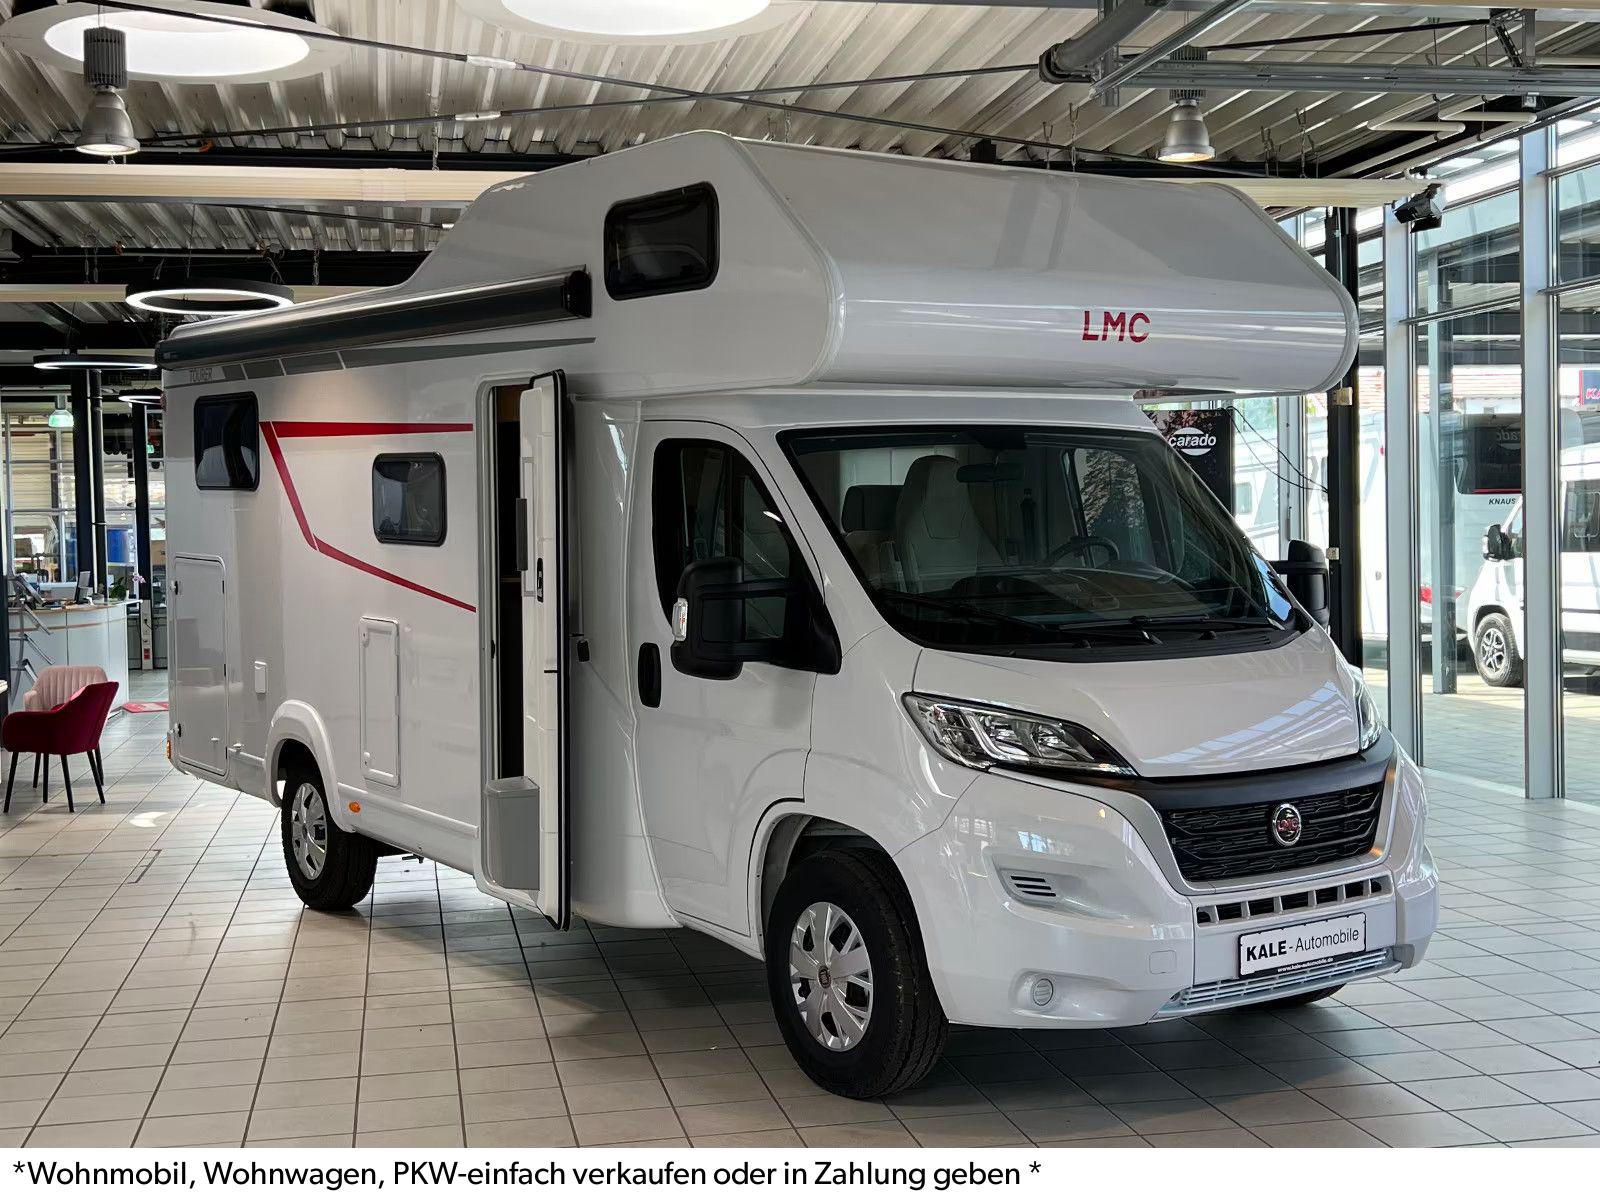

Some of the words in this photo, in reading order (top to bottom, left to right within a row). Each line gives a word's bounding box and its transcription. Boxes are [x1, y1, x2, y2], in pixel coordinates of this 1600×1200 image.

[1082, 311, 1151, 343] LMC
[1168, 433, 1217, 447] carado
[1488, 497, 1516, 505] KNAUS
[1246, 940, 1287, 961] KALE
[1295, 928, 1359, 952] Automobile
